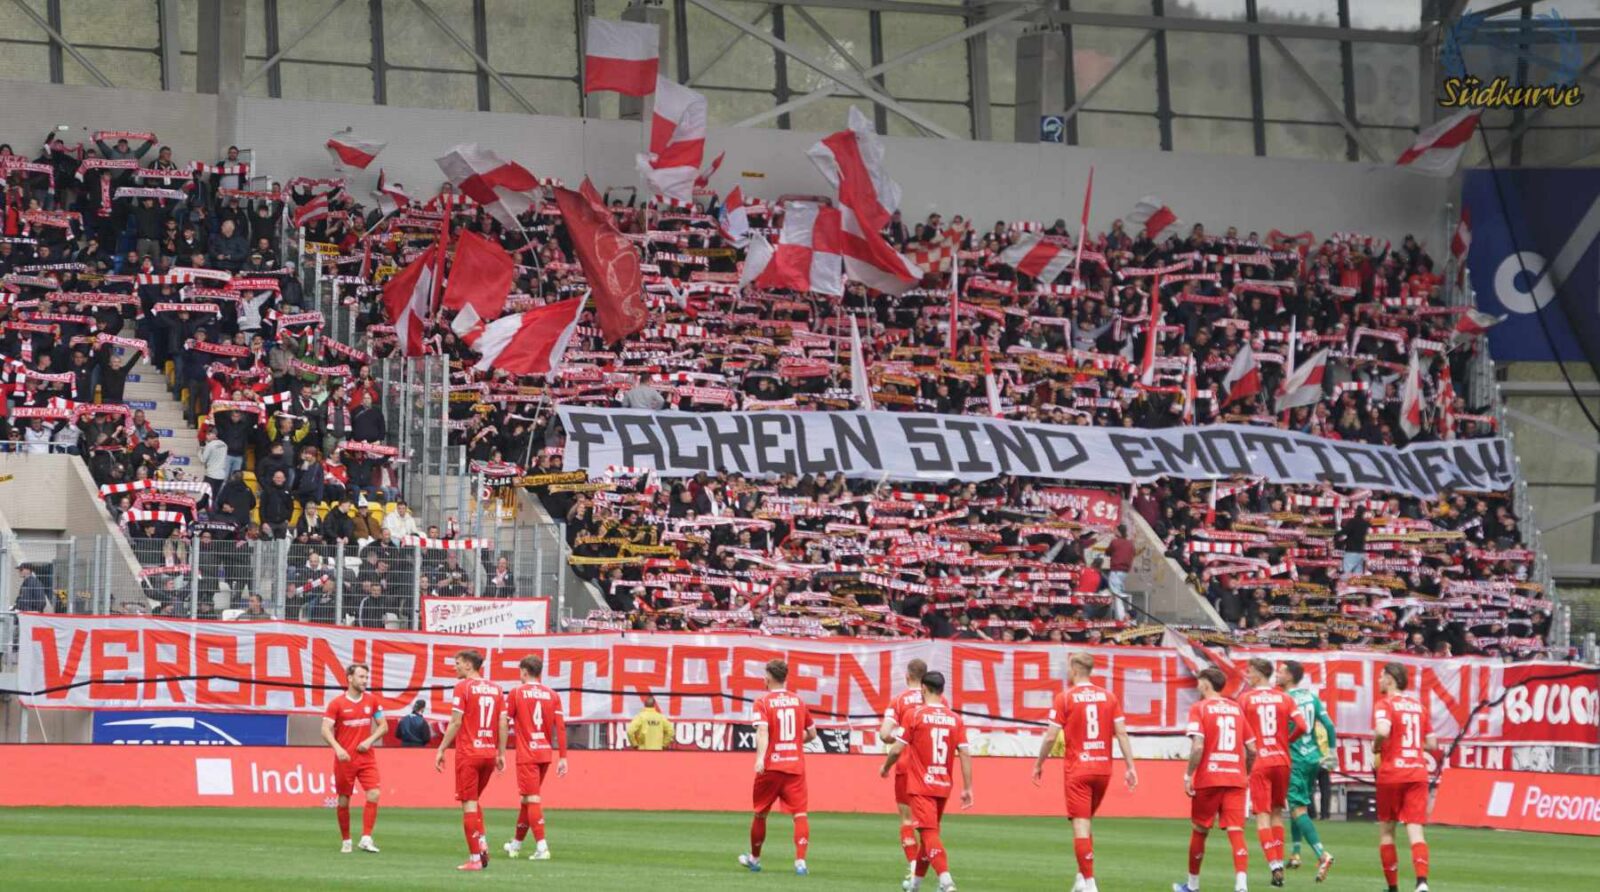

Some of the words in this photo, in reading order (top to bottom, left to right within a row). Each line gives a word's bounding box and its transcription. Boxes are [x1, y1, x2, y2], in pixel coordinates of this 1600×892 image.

[281, 313, 321, 325] ZWICKAU
[570, 412, 883, 474] FACKELN
[900, 417, 1090, 473] SIND
[1109, 430, 1512, 495] EMOTIONEN!
[860, 572, 890, 587] EGAL
[478, 695, 495, 729] 17
[532, 700, 544, 731] 4
[776, 708, 797, 742] 10
[1085, 703, 1100, 739] 8
[1256, 704, 1278, 736] 18
[930, 727, 950, 765] 15
[1215, 715, 1237, 751] 16
[1401, 712, 1421, 749] 31
